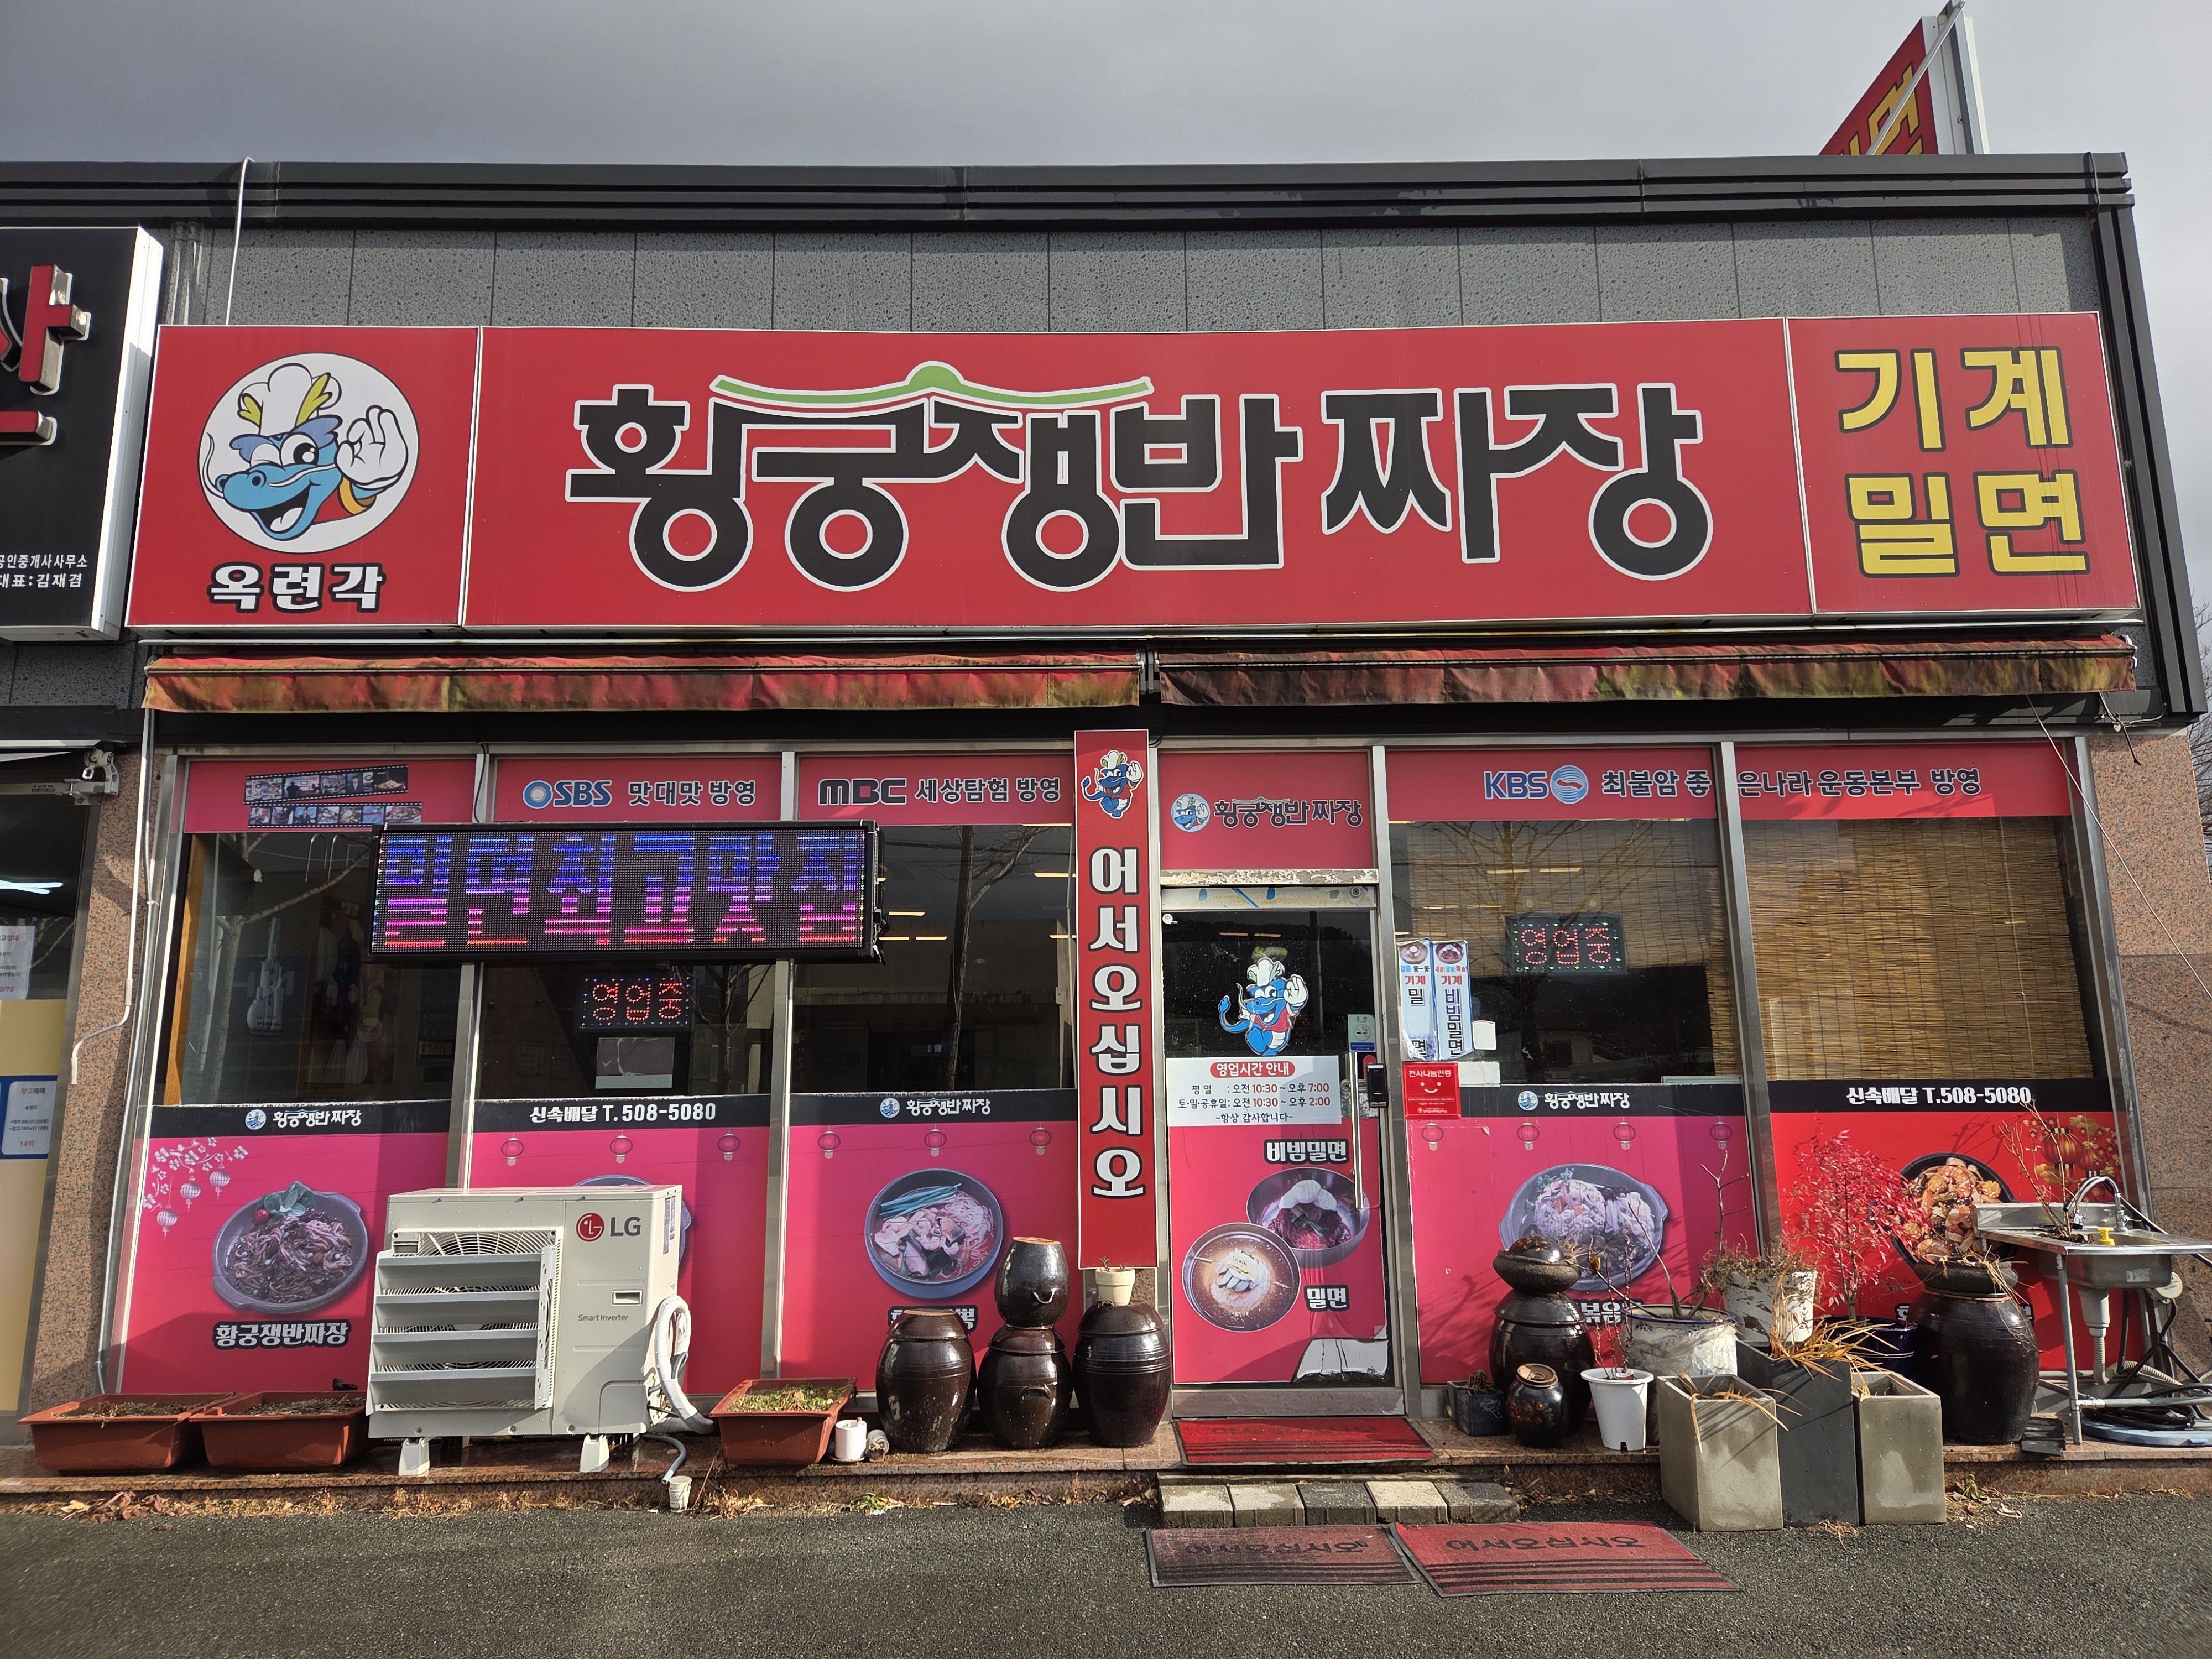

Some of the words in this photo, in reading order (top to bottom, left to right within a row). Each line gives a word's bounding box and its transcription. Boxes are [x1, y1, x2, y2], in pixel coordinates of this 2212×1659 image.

[1835, 347, 2073, 451] 기계
[1846, 472, 2089, 576] 밀면
[210, 563, 384, 612] 옥련각
[553, 780, 612, 807] SBS
[628, 780, 703, 807] 맛대맛
[708, 780, 756, 806] 방영
[818, 778, 907, 806] MBC
[915, 778, 1009, 802] 세상탐험
[1015, 777, 1061, 802] 방영
[1484, 771, 1549, 800] KBS
[1601, 770, 1679, 797] 최불암
[1930, 768, 1981, 795] 방영
[1520, 927, 1612, 966] 영업중
[1405, 975, 1426, 985] 기계
[1441, 975, 1462, 985] 기계
[593, 983, 682, 1021] 영업중
[1089, 847, 1146, 1198] 어서오십시오
[1444, 988, 1463, 1056] 비빔밀면
[1216, 1063, 1264, 1077] 영업시간
[1266, 1063, 1290, 1076] 안내
[1252, 1084, 1277, 1093] 10:30
[1288, 1083, 1306, 1093] 오후
[1308, 1083, 1329, 1092] 7:00
[1846, 1087, 1918, 1104] 신속배달
[530, 1106, 598, 1123] 신속배달
[1233, 1098, 1251, 1107] 오전
[1253, 1098, 1278, 1107] 10:30
[1289, 1098, 1307, 1107] 오후
[1309, 1097, 1330, 1106] 2:00
[1266, 1141, 1347, 1162] 비빔밀면
[610, 1217, 641, 1237] LG
[1306, 1287, 1347, 1309] 밀면
[216, 1322, 349, 1347] 황궁쟁반짜장
